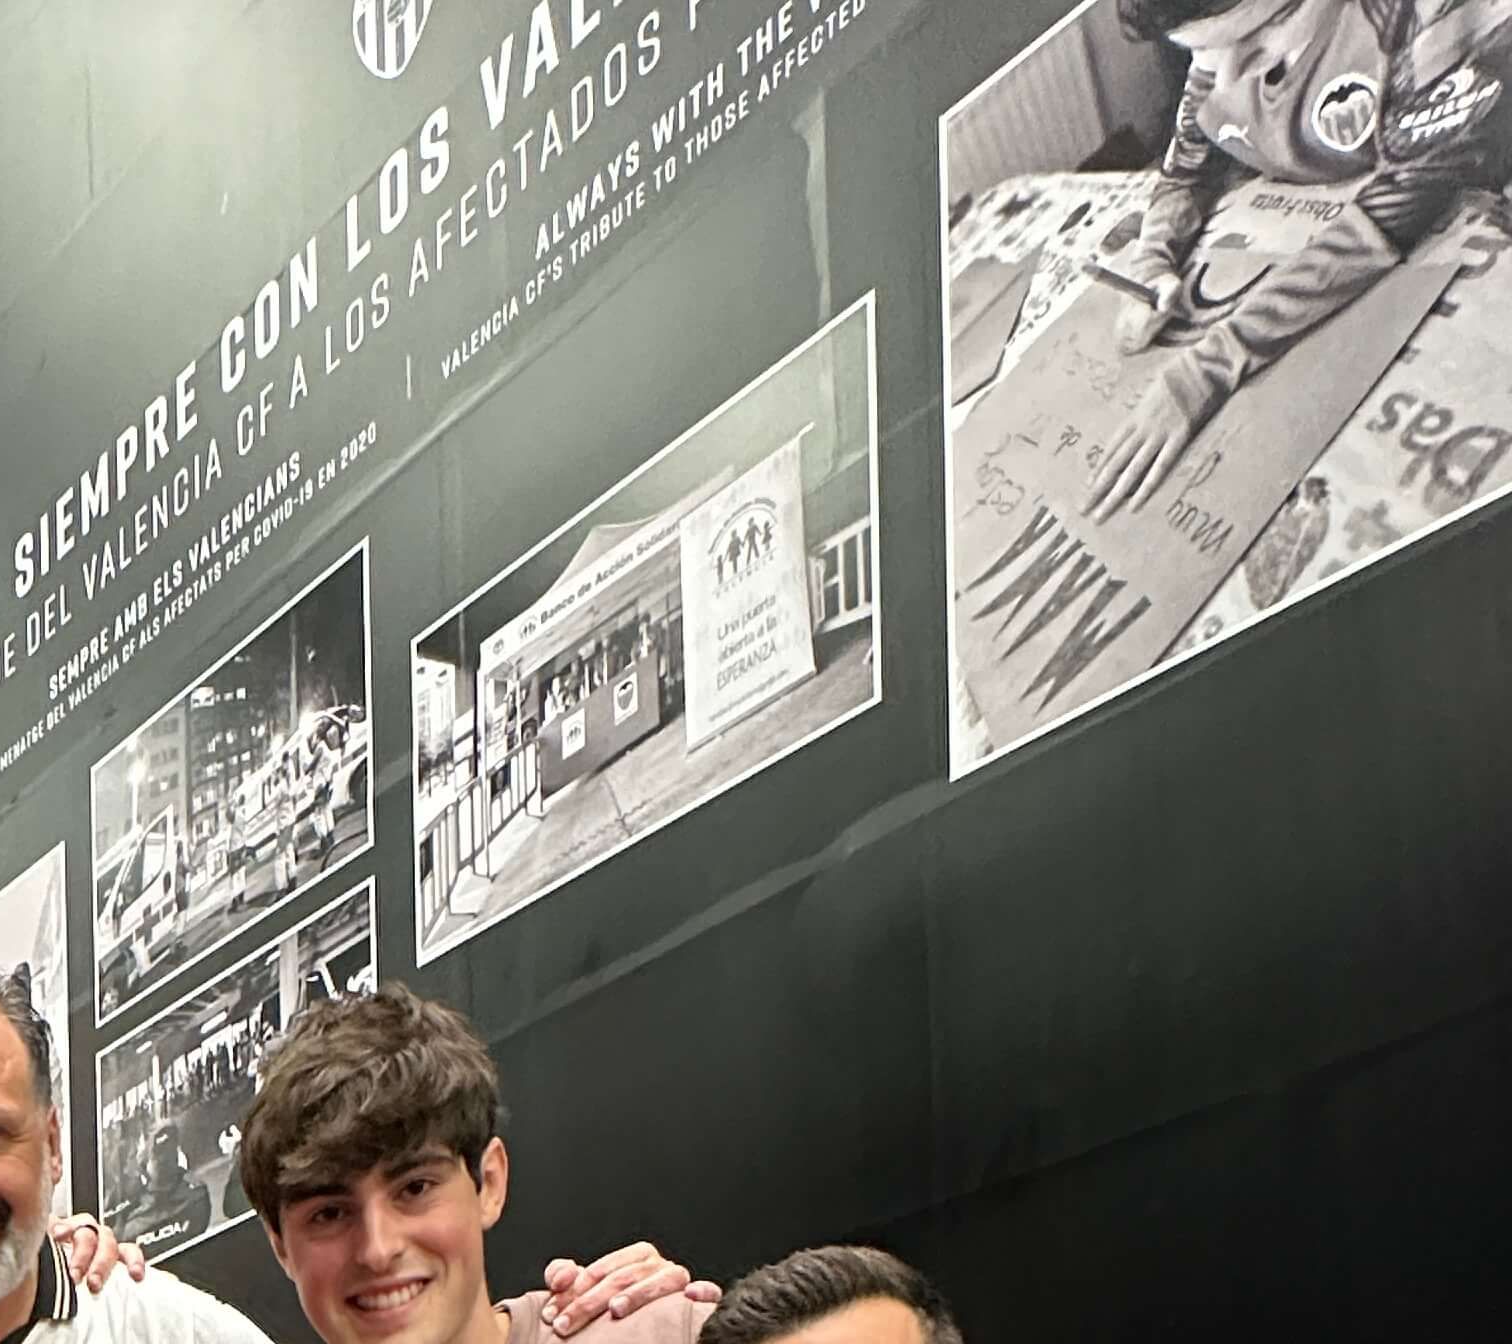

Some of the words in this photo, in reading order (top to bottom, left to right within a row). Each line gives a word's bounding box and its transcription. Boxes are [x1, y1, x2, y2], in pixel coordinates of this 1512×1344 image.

[441, 295, 519, 379] VALENCIA
[525, 255, 562, 305] CF'S
[569, 182, 645, 265] TRIBUTE
[653, 156, 676, 192] TO
[684, 90, 750, 163] THOSE
[758, 0, 865, 102] AFFECTED
[536, 140, 639, 260] ALWAYS
[651, 63, 723, 152] WITH
[737, 2, 793, 77] THE
[14, 360, 198, 598] SIEMPRE
[220, 238, 318, 392] CON
[346, 105, 450, 272] LOS
[480, 0, 624, 130] VAL
[25, 584, 72, 656] DEL
[82, 438, 222, 600] VALENCIA
[237, 382, 273, 455] CF
[289, 354, 308, 409] A
[325, 272, 389, 375] LOS
[408, 9, 661, 298] AFECTADOS
[46, 703, 66, 731] DEL
[68, 654, 119, 710] VALENCIA
[122, 638, 136, 663] CF
[139, 616, 160, 649] ALS
[163, 561, 221, 627] AFECTATS
[226, 535, 249, 571] PER
[254, 479, 313, 545] COVID-19
[318, 458, 336, 489] EN
[340, 421, 377, 469] 2020
[49, 627, 109, 700] SEMPRE
[114, 592, 148, 642] AMB
[153, 559, 183, 605] ELS
[188, 451, 300, 571] VALENCIANS
[540, 594, 576, 625] Banco
